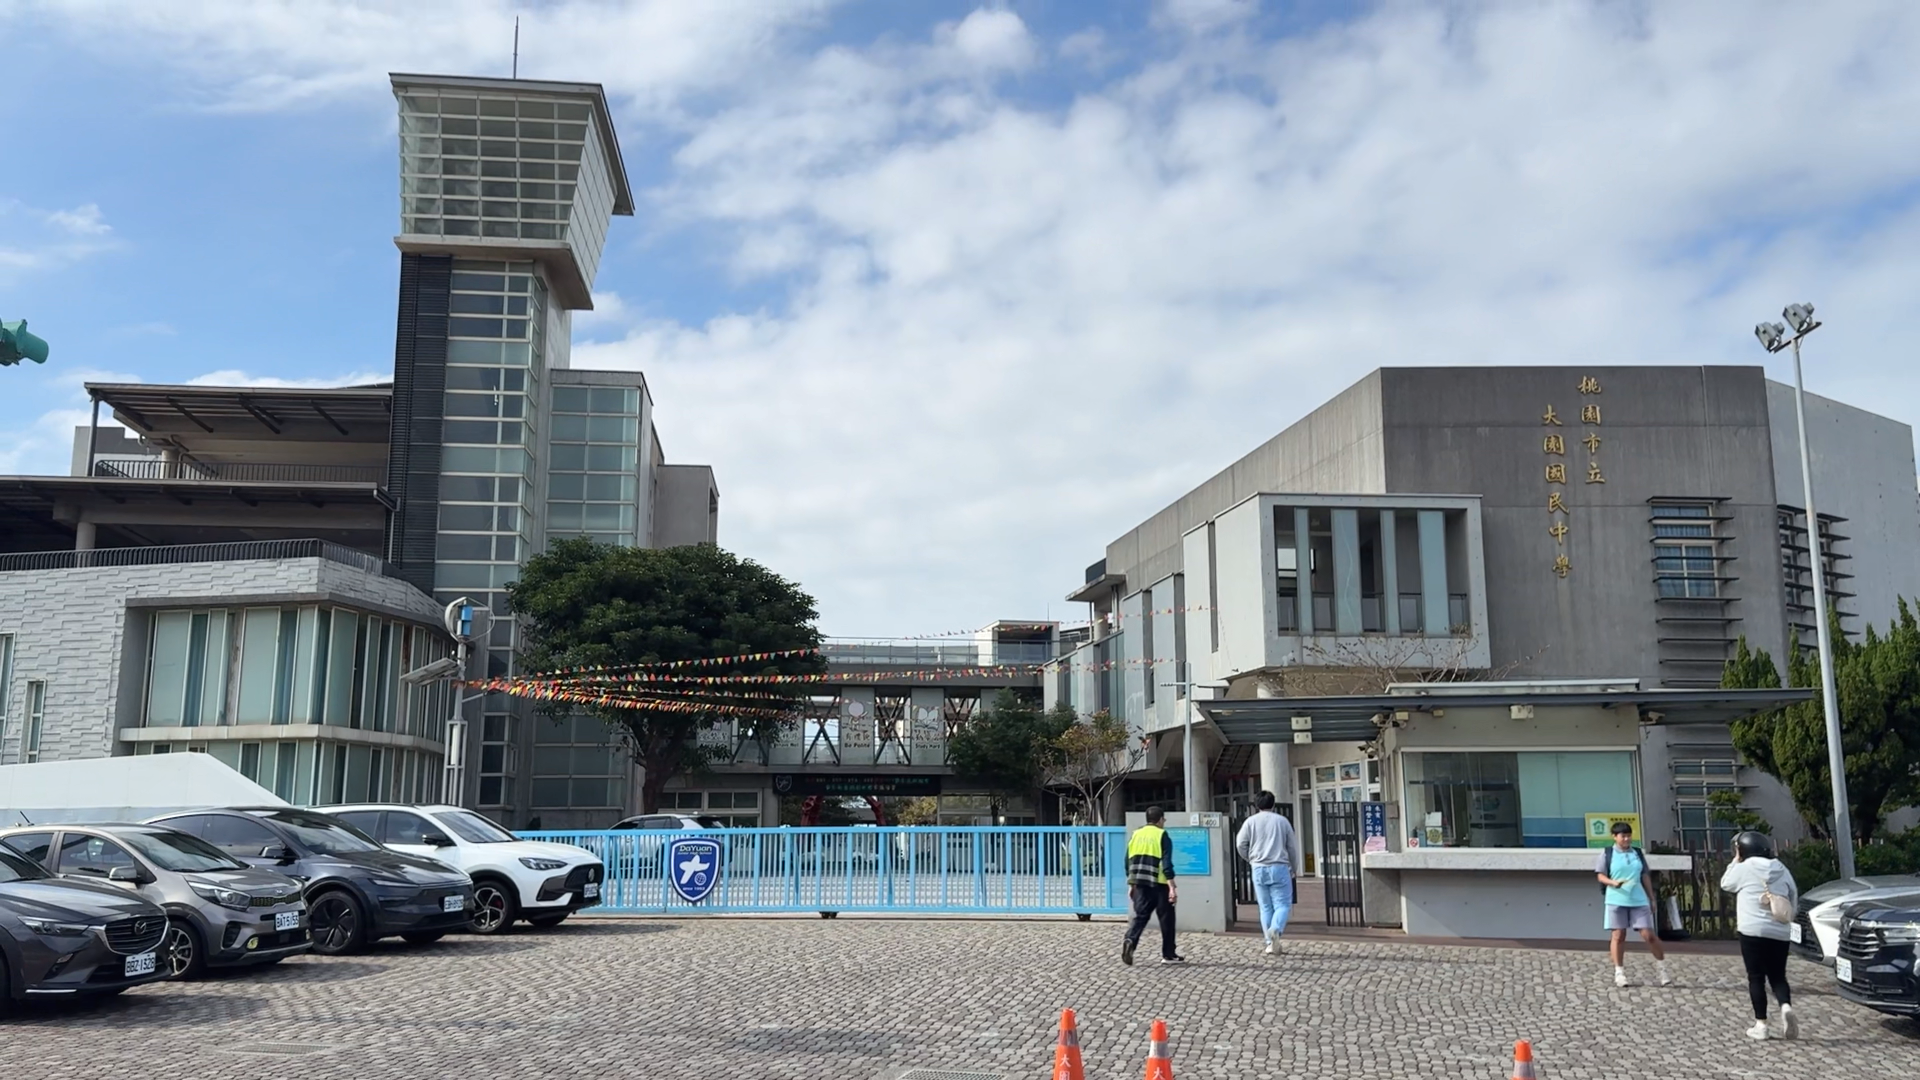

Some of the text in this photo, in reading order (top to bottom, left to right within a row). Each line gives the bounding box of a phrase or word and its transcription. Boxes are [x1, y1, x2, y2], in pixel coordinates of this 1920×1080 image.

[1541, 404, 1573, 579] 大園國民中學
[1577, 375, 1605, 484] 桃園市立
